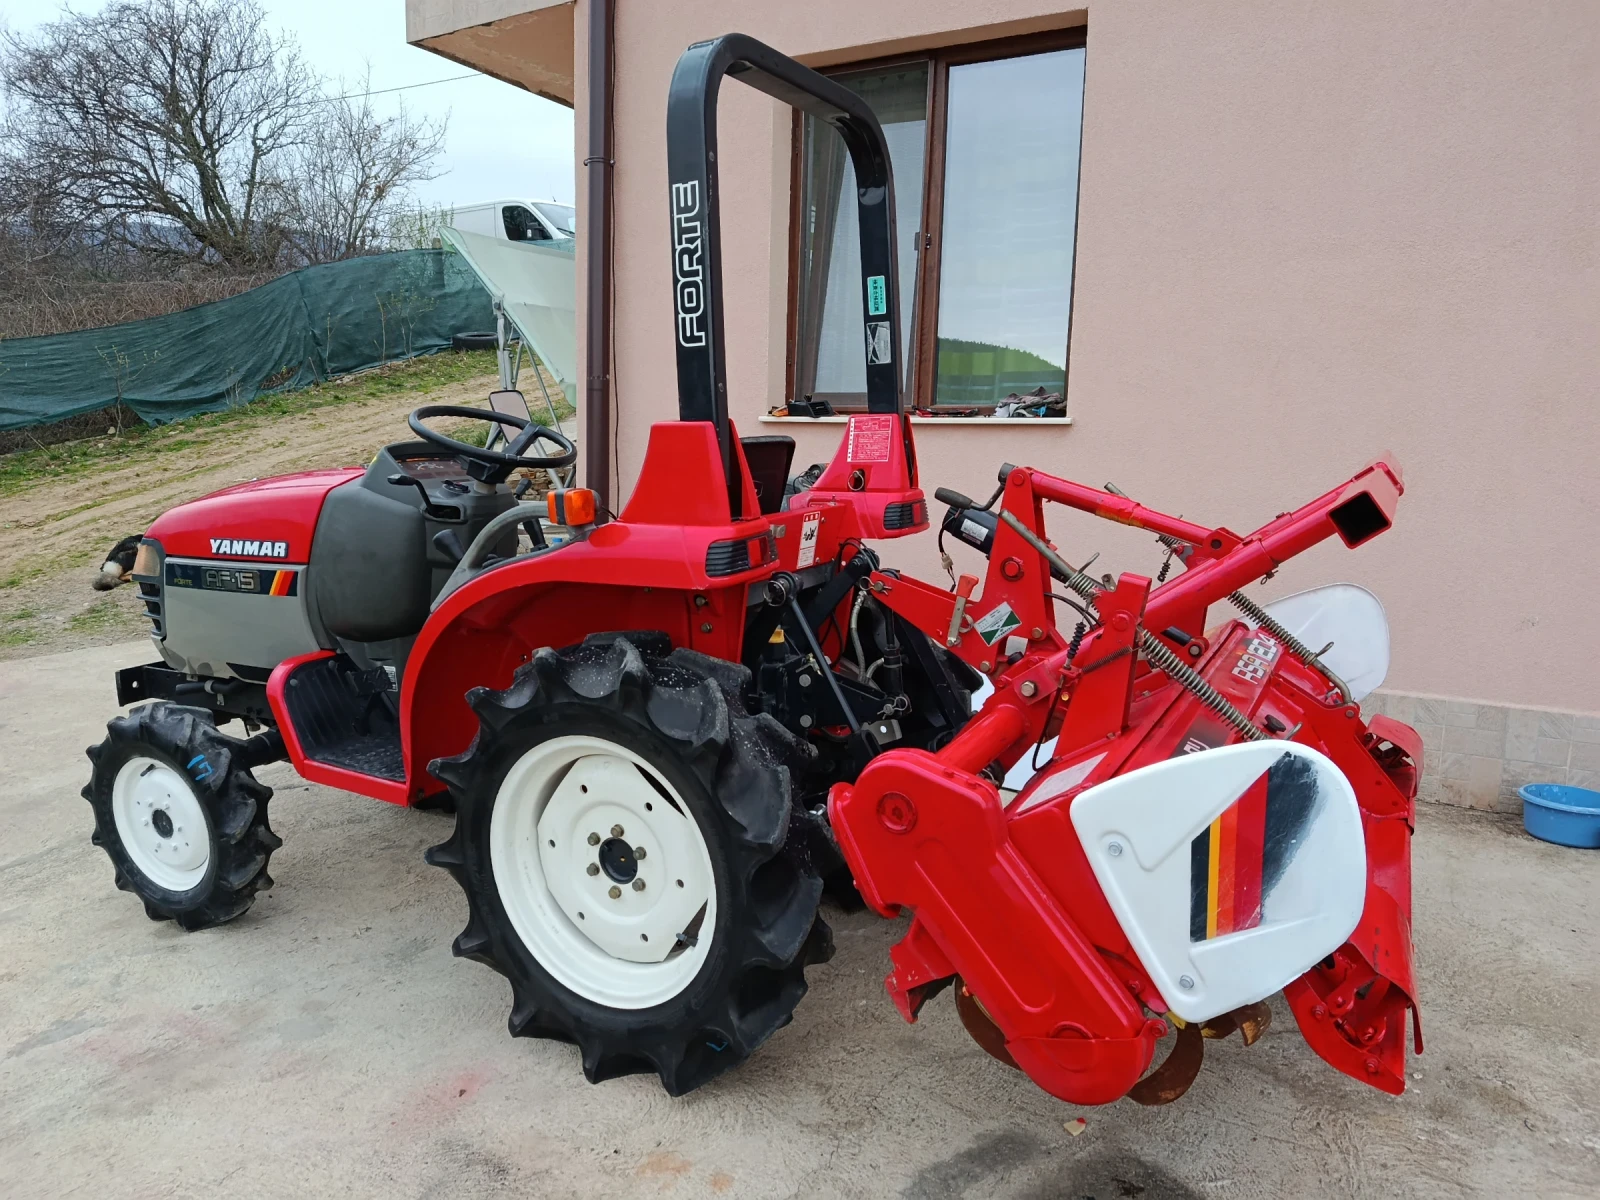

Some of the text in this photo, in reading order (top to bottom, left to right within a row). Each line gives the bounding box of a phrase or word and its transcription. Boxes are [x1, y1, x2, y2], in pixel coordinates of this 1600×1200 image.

[672, 180, 706, 347] FORTE
[209, 538, 286, 557] YANMAR
[173, 577, 193, 586] FORTE
